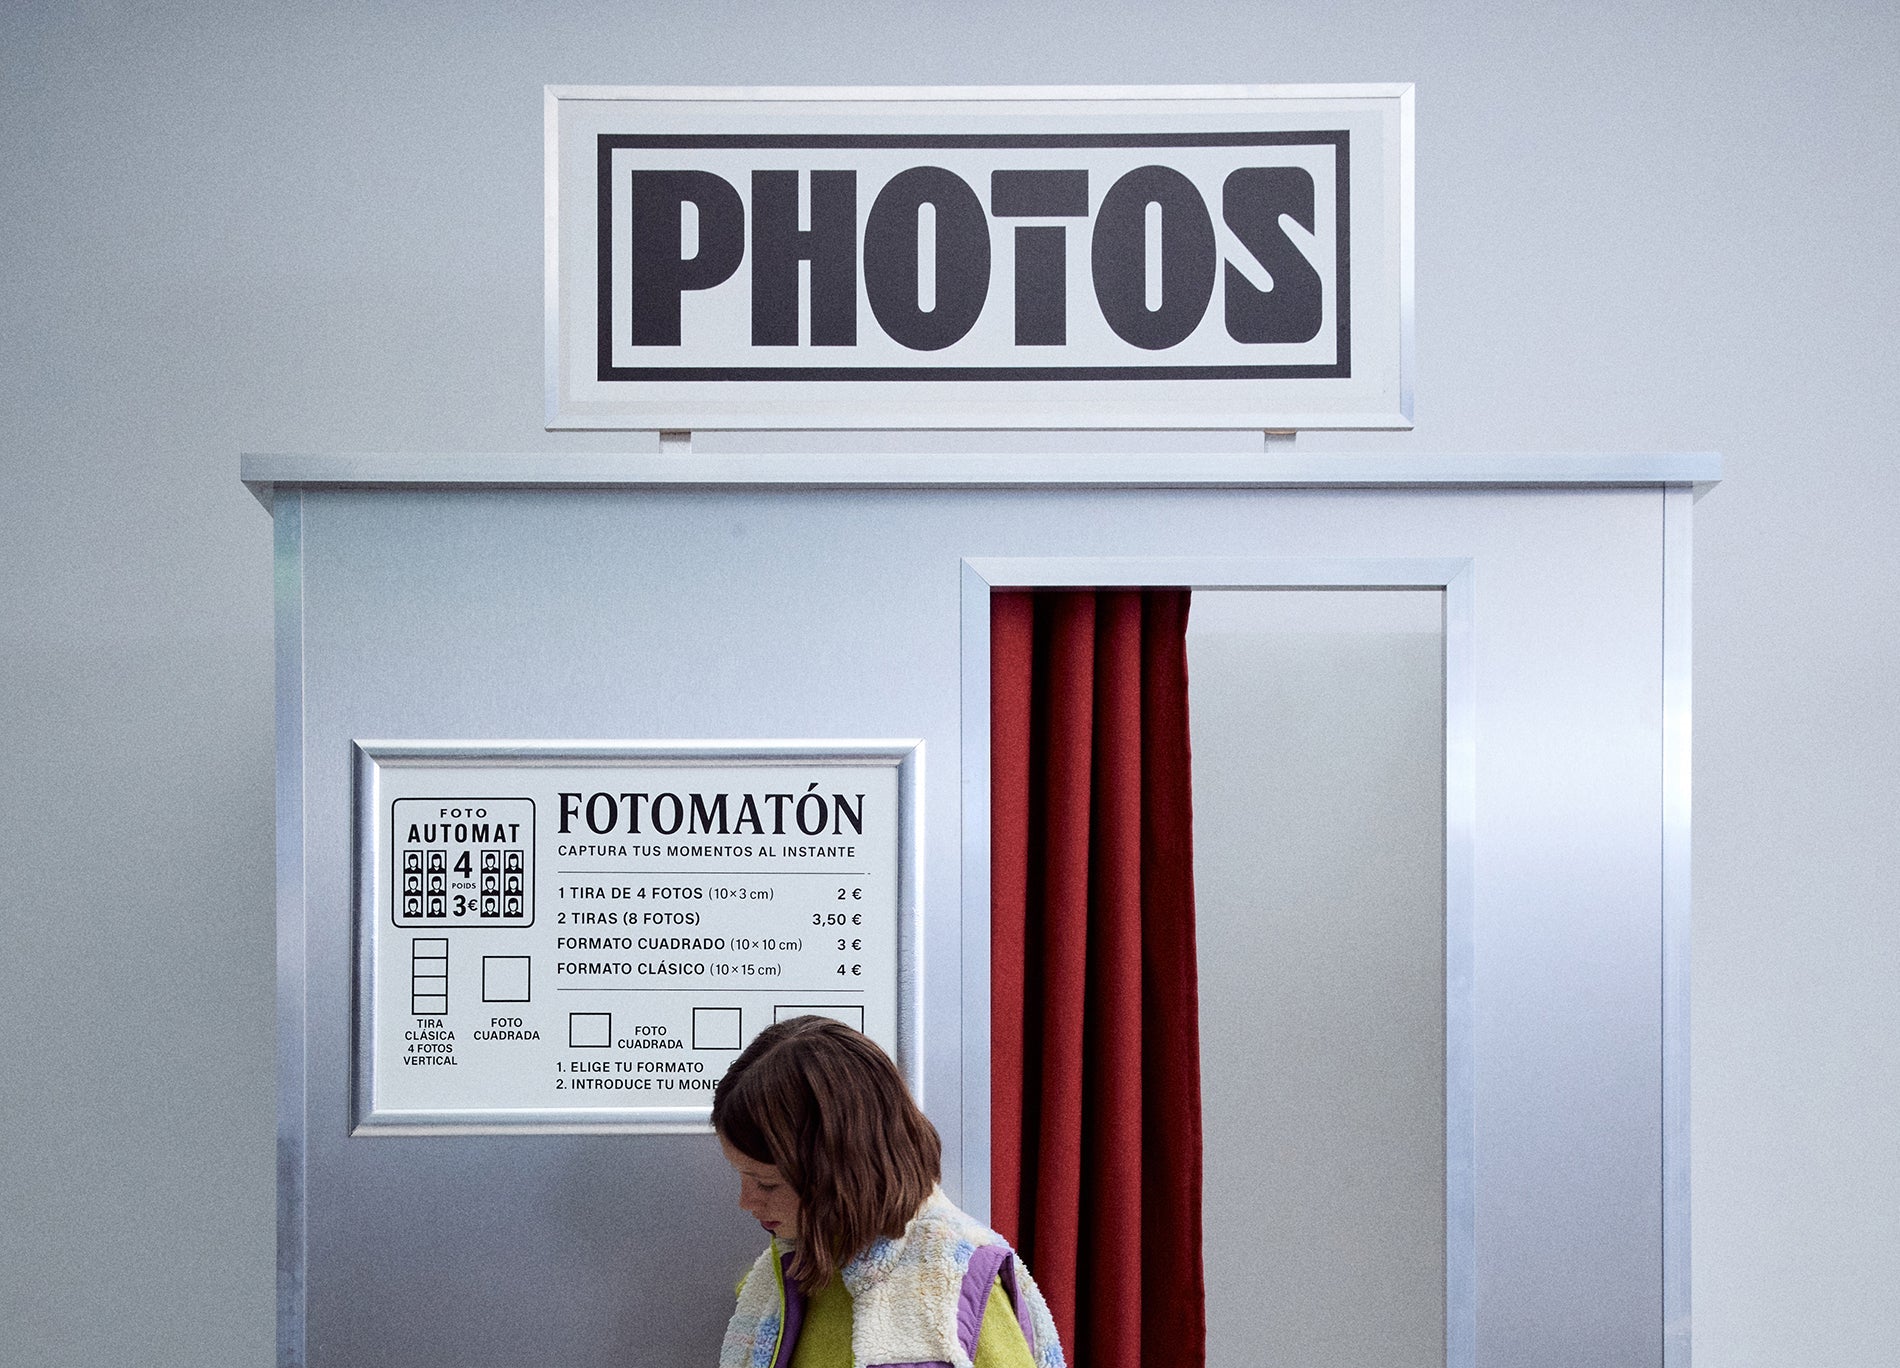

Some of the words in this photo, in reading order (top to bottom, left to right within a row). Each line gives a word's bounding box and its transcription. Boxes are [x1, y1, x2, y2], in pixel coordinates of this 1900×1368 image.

[632, 165, 1322, 351] PHOTOS
[440, 808, 487, 819] FOTO
[557, 782, 866, 836] FOTOMATÓN
[407, 823, 520, 844] AUTOMAT
[557, 844, 628, 857] CAPTURA
[632, 845, 661, 857] TUS
[667, 845, 753, 858] MOMENTOS
[758, 846, 777, 857] AL
[783, 846, 855, 858] INSTANTE
[453, 850, 473, 879] 4
[558, 886, 564, 899] 1
[569, 886, 606, 900] TIRA
[611, 887, 632, 900] DE
[636, 887, 647, 900] 4
[652, 887, 703, 900] FOTOS
[837, 887, 846, 900] 2
[851, 887, 862, 901] €
[557, 912, 566, 925] 2
[571, 912, 618, 925] TIRAS
[623, 911, 638, 926] (8
[643, 911, 700, 926] FOTOS)
[812, 913, 847, 928] 3,50
[851, 913, 862, 926] €
[557, 937, 633, 950] FORMATO
[637, 937, 725, 950] CUADRADO
[837, 938, 846, 951] 3
[851, 938, 862, 951] €
[557, 962, 633, 975] FORMATO
[637, 959, 705, 976] CLÁSICO
[836, 964, 847, 976] 4
[851, 963, 862, 976] €
[416, 1018, 444, 1029] TIRA
[491, 1017, 523, 1028] FOTO
[404, 1028, 456, 1041] CLÁSICA
[473, 1030, 541, 1041] CUADRADA
[634, 1025, 667, 1036] FOTO
[407, 1043, 415, 1053] 4
[417, 1043, 453, 1054] FOTOS
[617, 1038, 684, 1049] CUADRADA
[402, 1055, 458, 1066] VERTICAL
[556, 1061, 566, 1073] 1.
[570, 1061, 610, 1073] ELIGE
[614, 1061, 633, 1073] TU
[637, 1061, 704, 1073] FORMATO
[555, 1078, 567, 1090] 2.
[571, 1078, 652, 1090] INTRODUCE
[656, 1078, 674, 1090] TU
